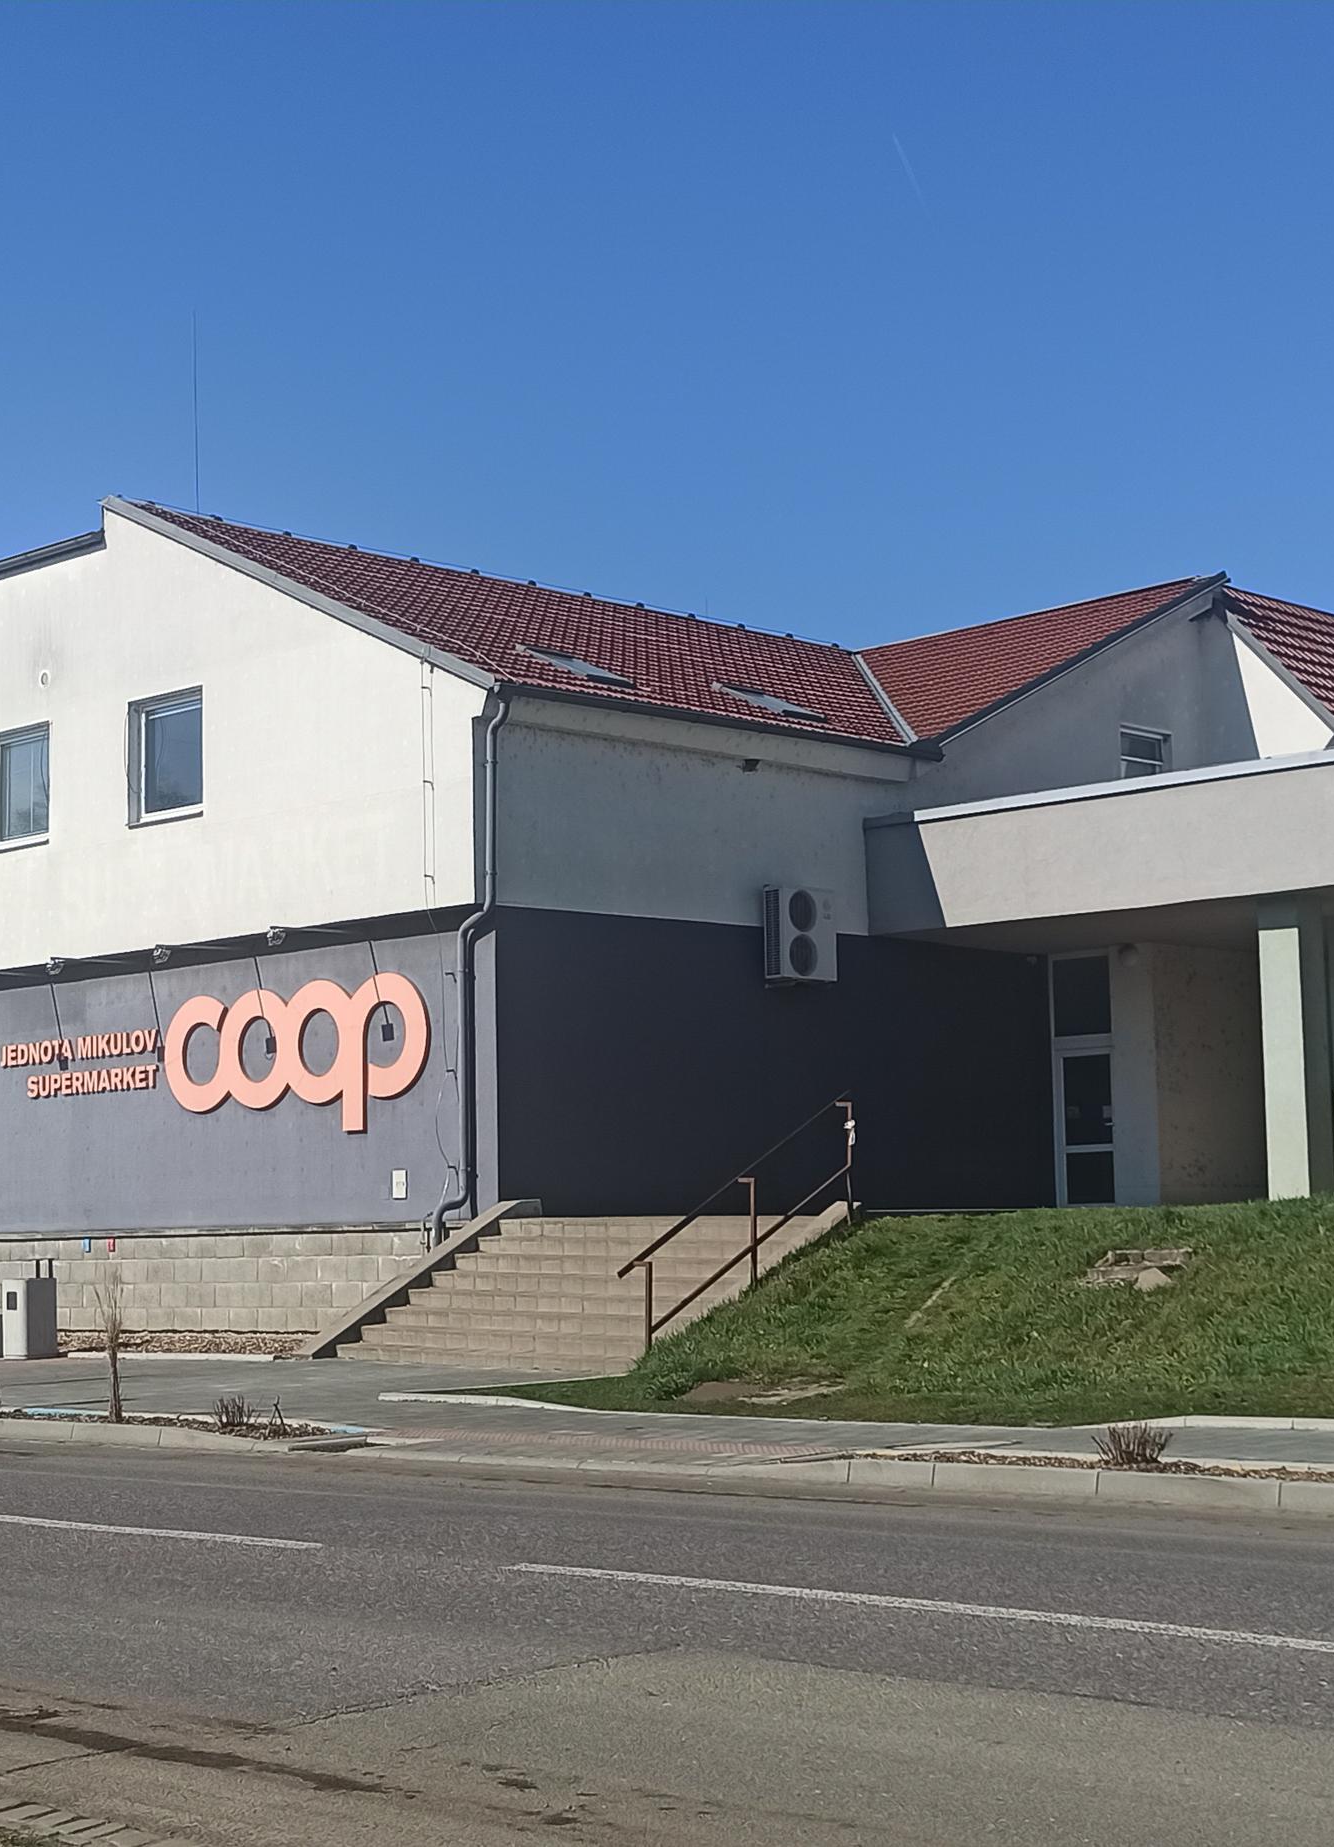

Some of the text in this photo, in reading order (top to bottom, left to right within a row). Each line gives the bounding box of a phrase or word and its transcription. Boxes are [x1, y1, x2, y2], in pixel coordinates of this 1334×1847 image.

[0, 1029, 157, 1068] JEDNOTA MIKULOV
[164, 972, 430, 1132] coop
[27, 1065, 157, 1099] SUPERMARKET
